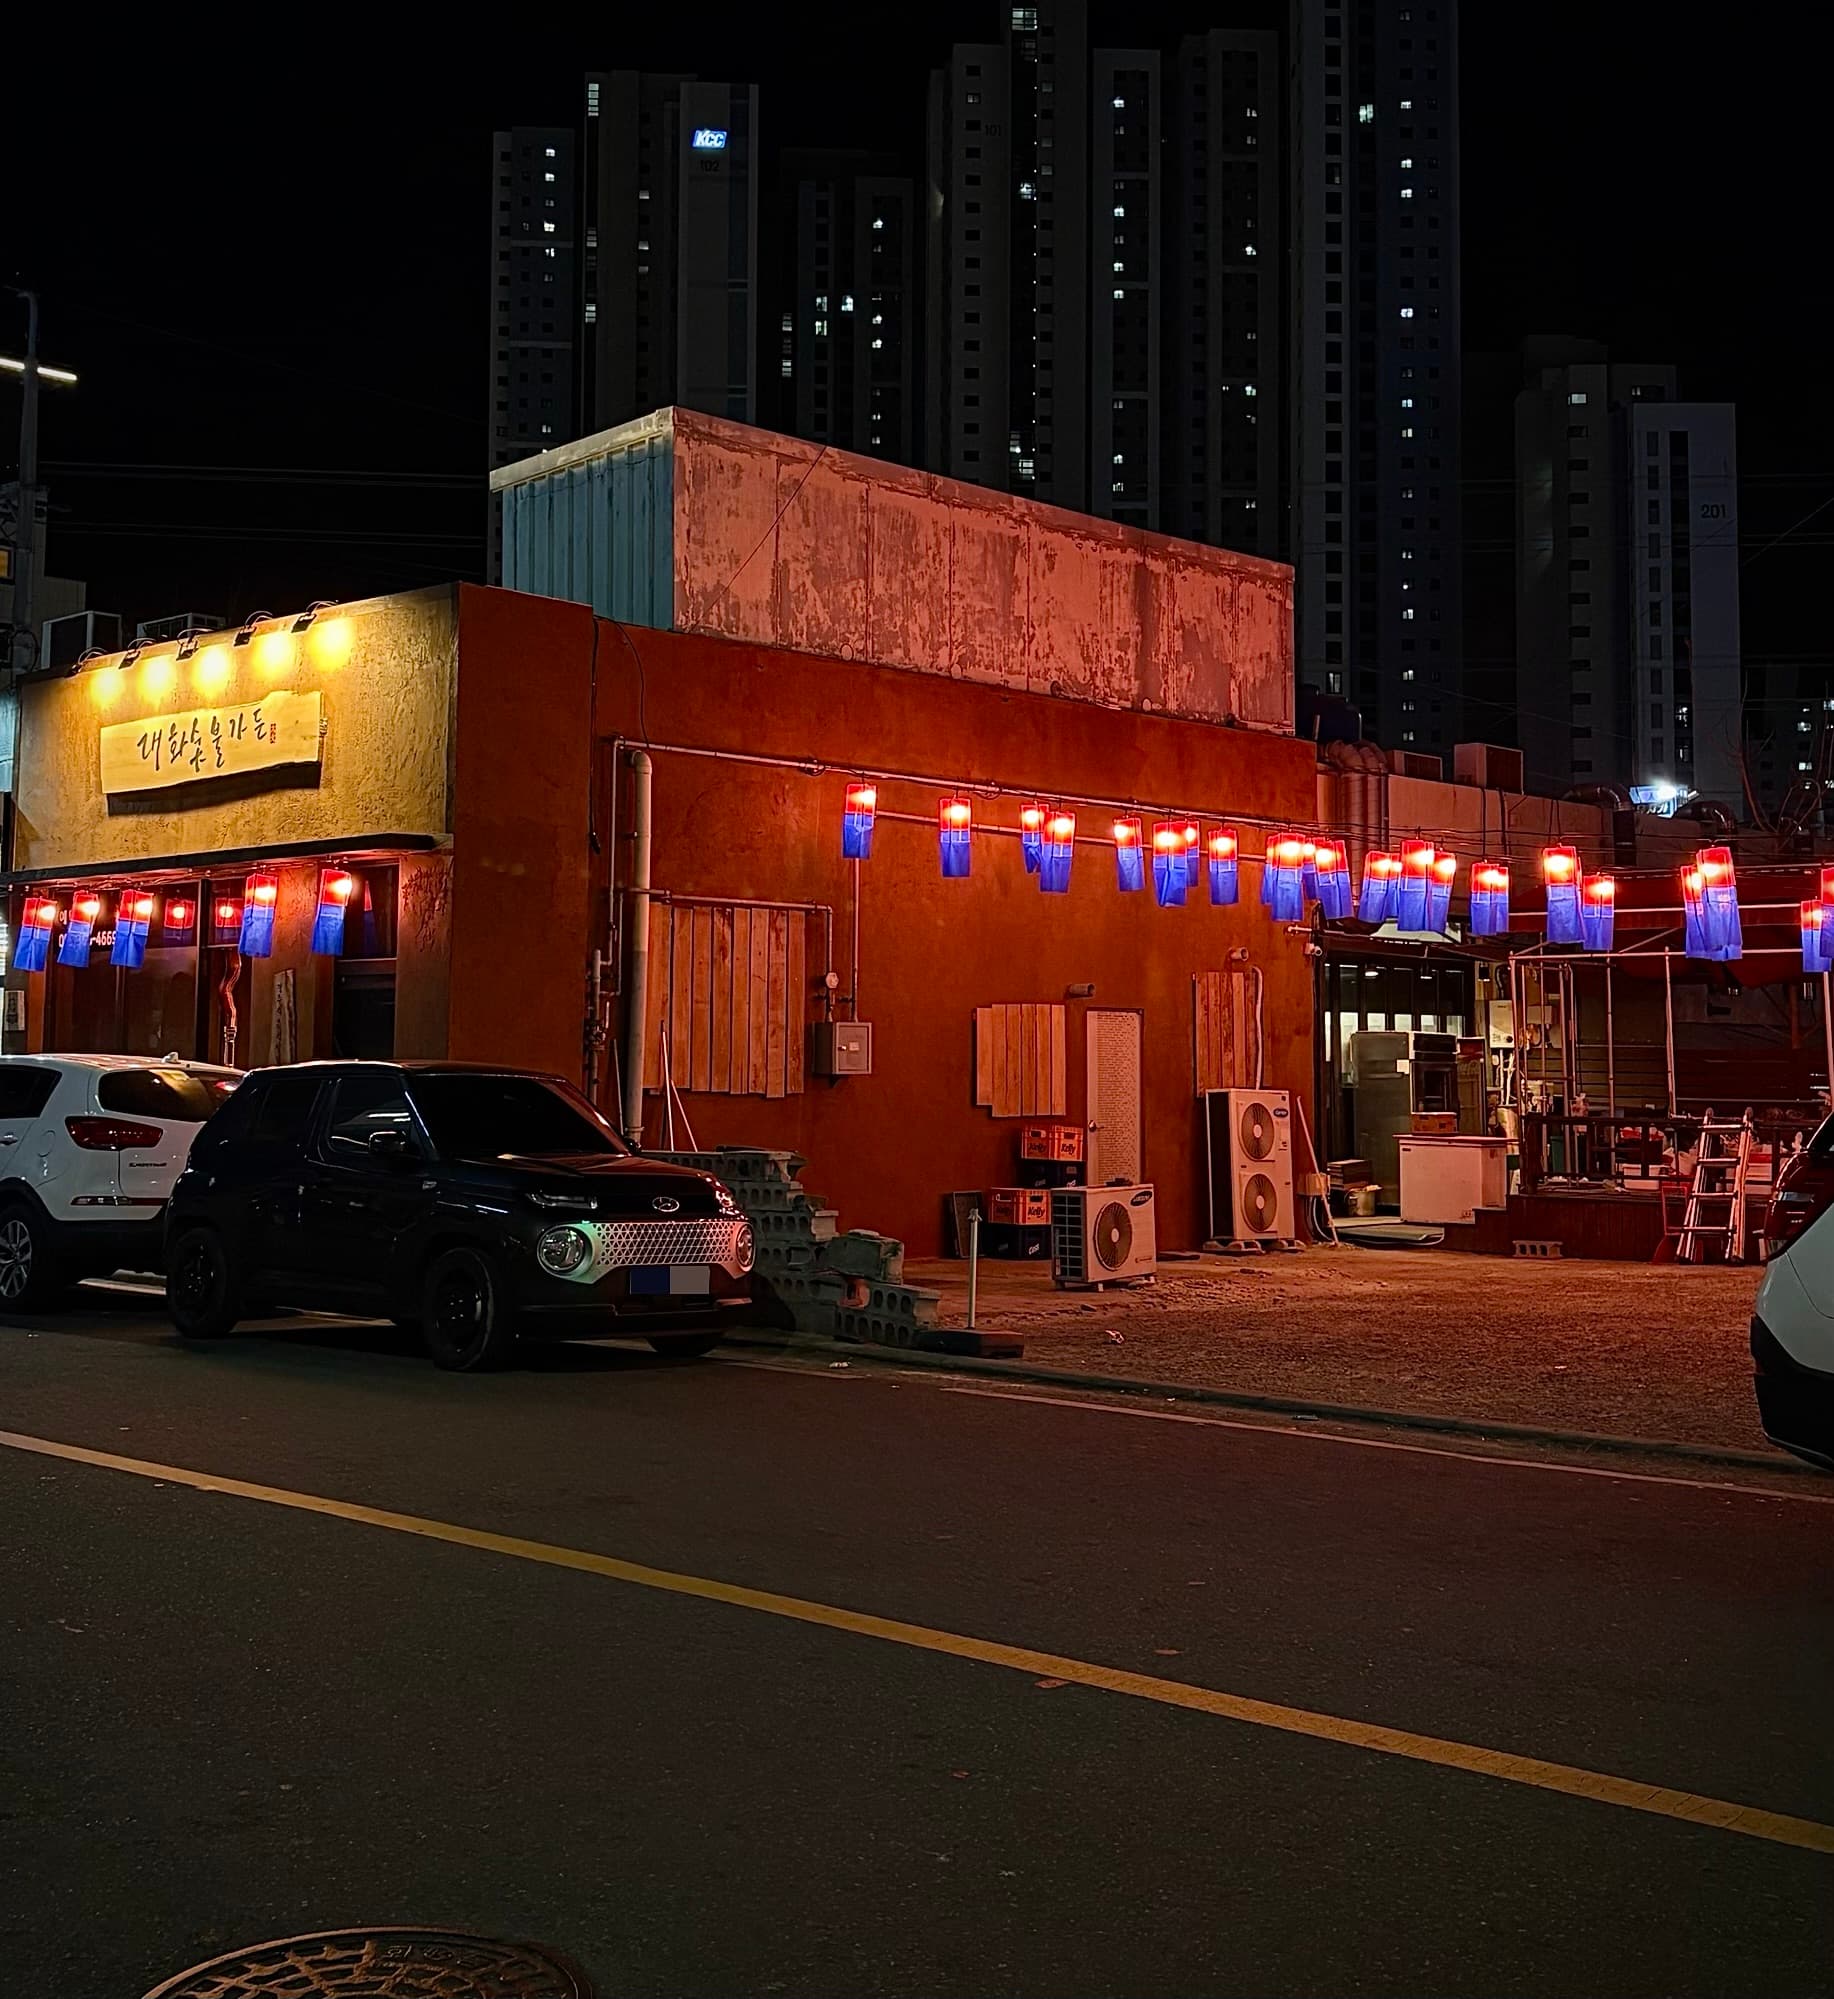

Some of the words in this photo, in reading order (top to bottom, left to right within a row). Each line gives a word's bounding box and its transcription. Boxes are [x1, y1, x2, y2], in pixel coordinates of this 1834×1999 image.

[695, 129, 725, 148] KCC
[701, 160, 720, 171] 102
[1701, 504, 1726, 519] 201
[1061, 1144, 1076, 1155] Kelly
[1028, 1206, 1046, 1218] Kelly
